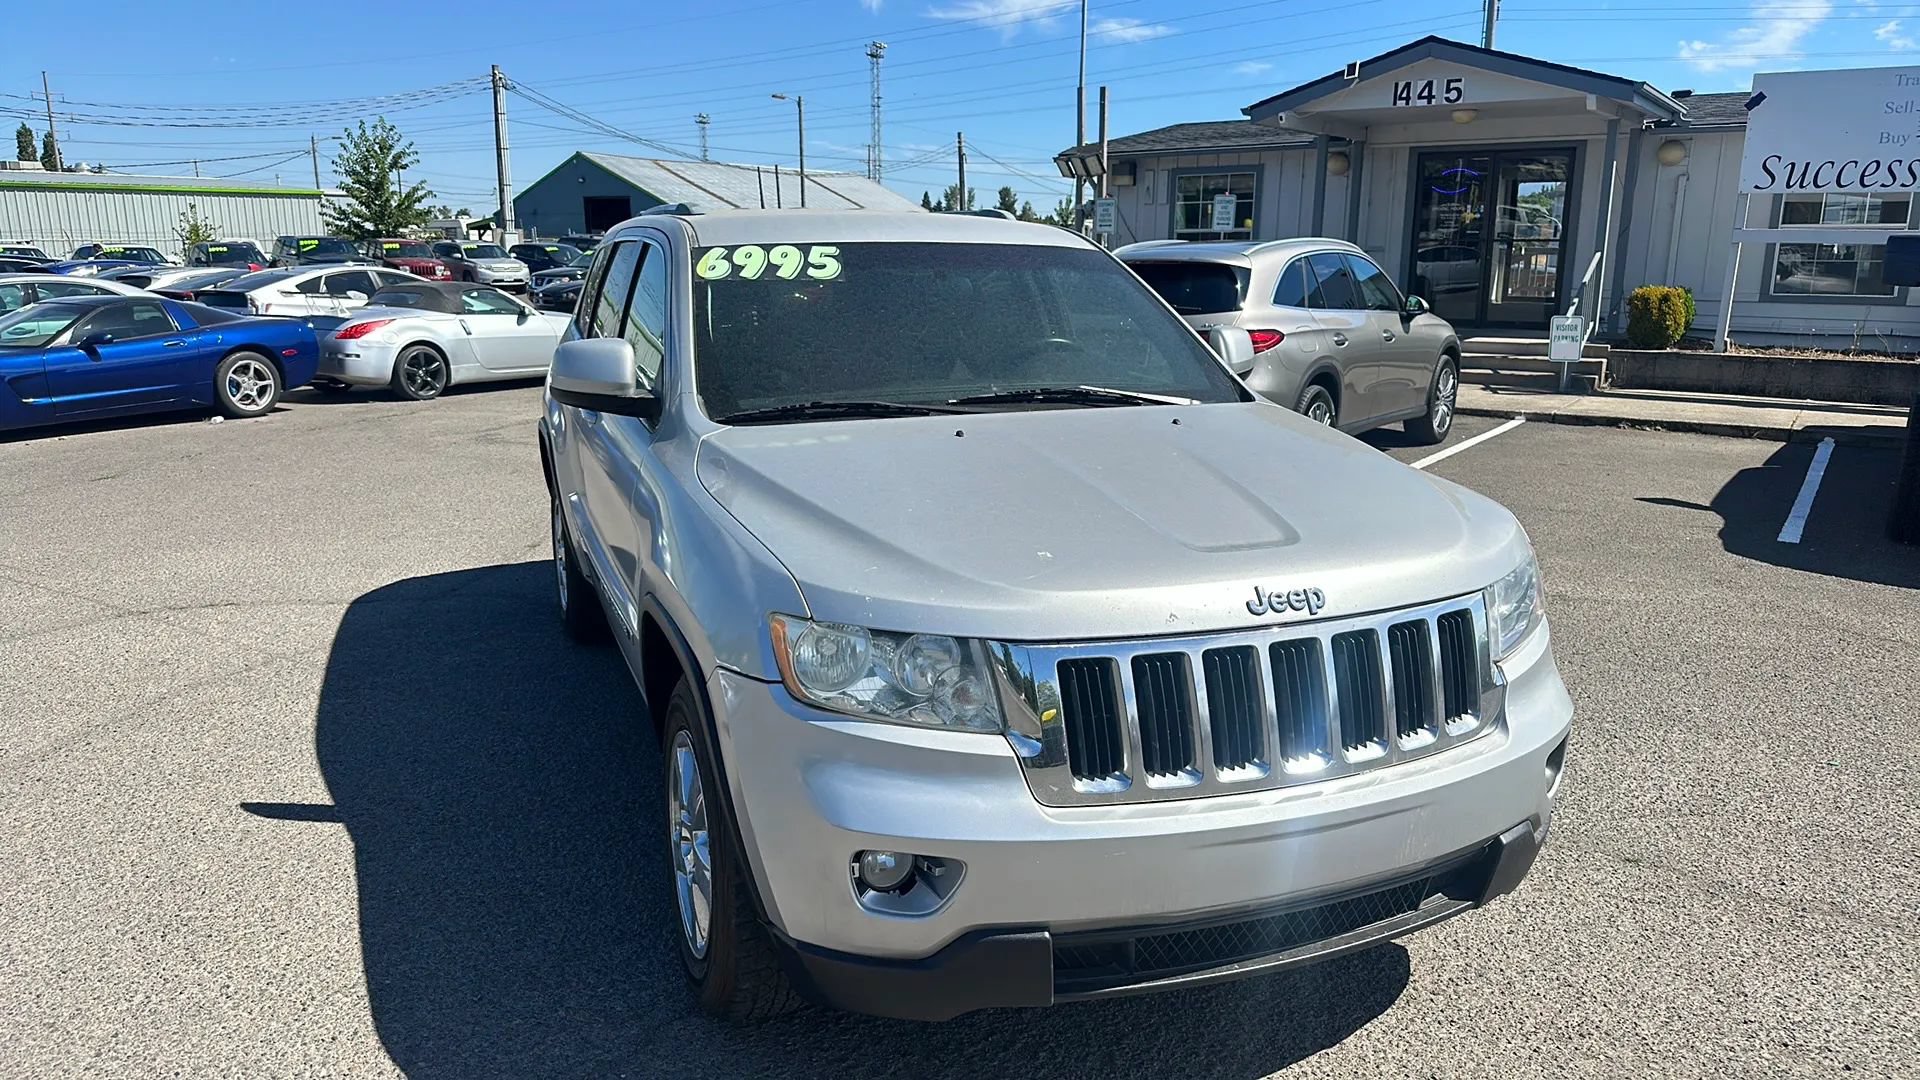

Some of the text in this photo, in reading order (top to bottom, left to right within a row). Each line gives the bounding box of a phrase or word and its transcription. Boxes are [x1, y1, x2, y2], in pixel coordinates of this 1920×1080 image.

[1895, 73, 1920, 87] Tra
[1392, 78, 1463, 106] 1445
[1884, 100, 1914, 114] Sell
[1879, 131, 1911, 147] Buy
[1753, 154, 1920, 190] Success
[696, 245, 842, 280] 6995
[1555, 323, 1578, 332] VISITOR
[1553, 335, 1579, 343] PARKING
[1245, 585, 1326, 616] Jeep
